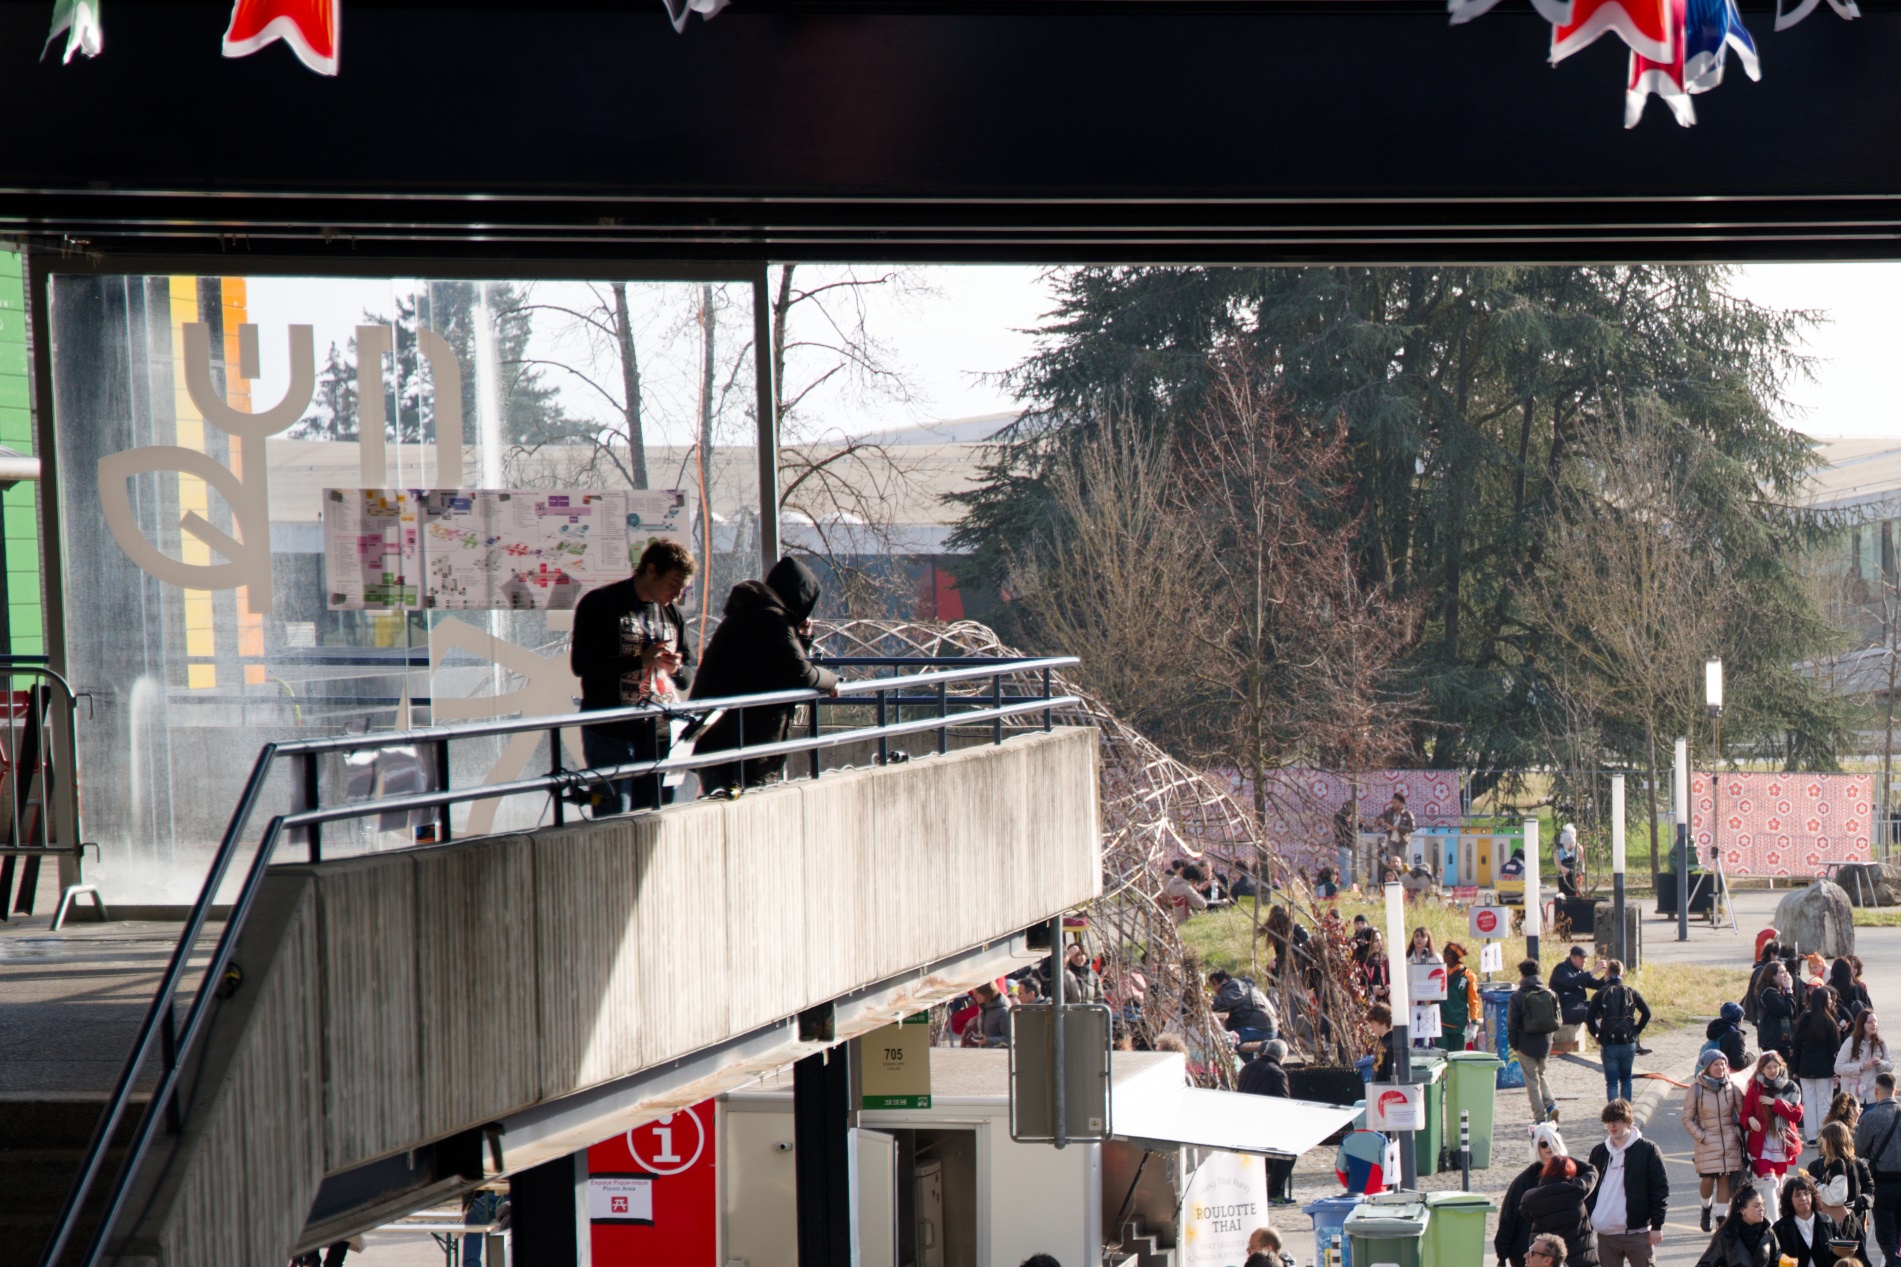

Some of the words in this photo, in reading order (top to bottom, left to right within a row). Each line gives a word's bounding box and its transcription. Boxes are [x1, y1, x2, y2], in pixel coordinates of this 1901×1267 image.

[884, 1048, 903, 1060] 705
[1196, 1203, 1257, 1220] ROULOTTE
[1212, 1219, 1242, 1233] THAI
